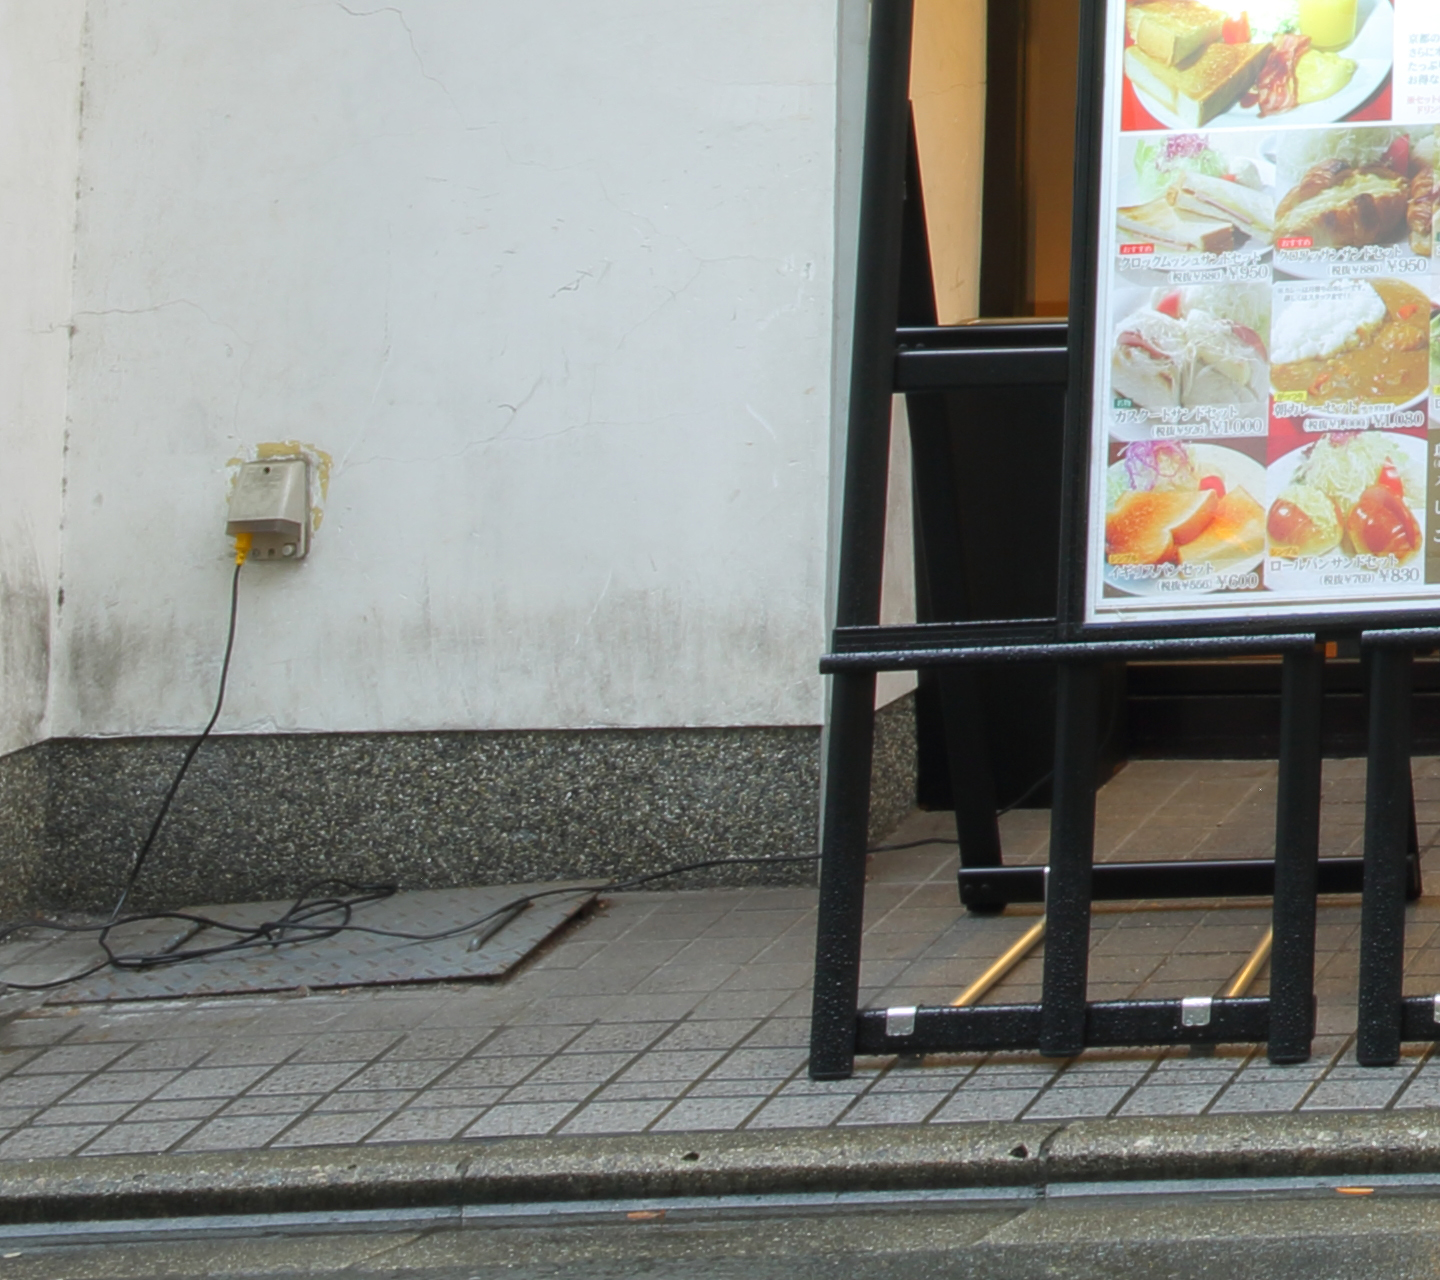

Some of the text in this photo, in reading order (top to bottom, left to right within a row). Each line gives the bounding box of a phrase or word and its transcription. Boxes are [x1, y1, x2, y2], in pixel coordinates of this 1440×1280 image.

[1122, 245, 1153, 253] おすすめ
[1281, 238, 1312, 247] おすすめ
[1119, 252, 1261, 270] クロックムッシュサンドセット
[1386, 258, 1427, 273] ¥950
[1227, 265, 1270, 280] ¥950
[1115, 405, 1238, 423] カスクートサンドセット
[1273, 401, 1356, 417] 朝カレーセット
[1110, 561, 1214, 579] イギリスパンセット
[1270, 553, 1398, 572] ロールパンサンドセット
[1217, 573, 1259, 589] ¥600
[1378, 567, 1420, 582] ¥830
